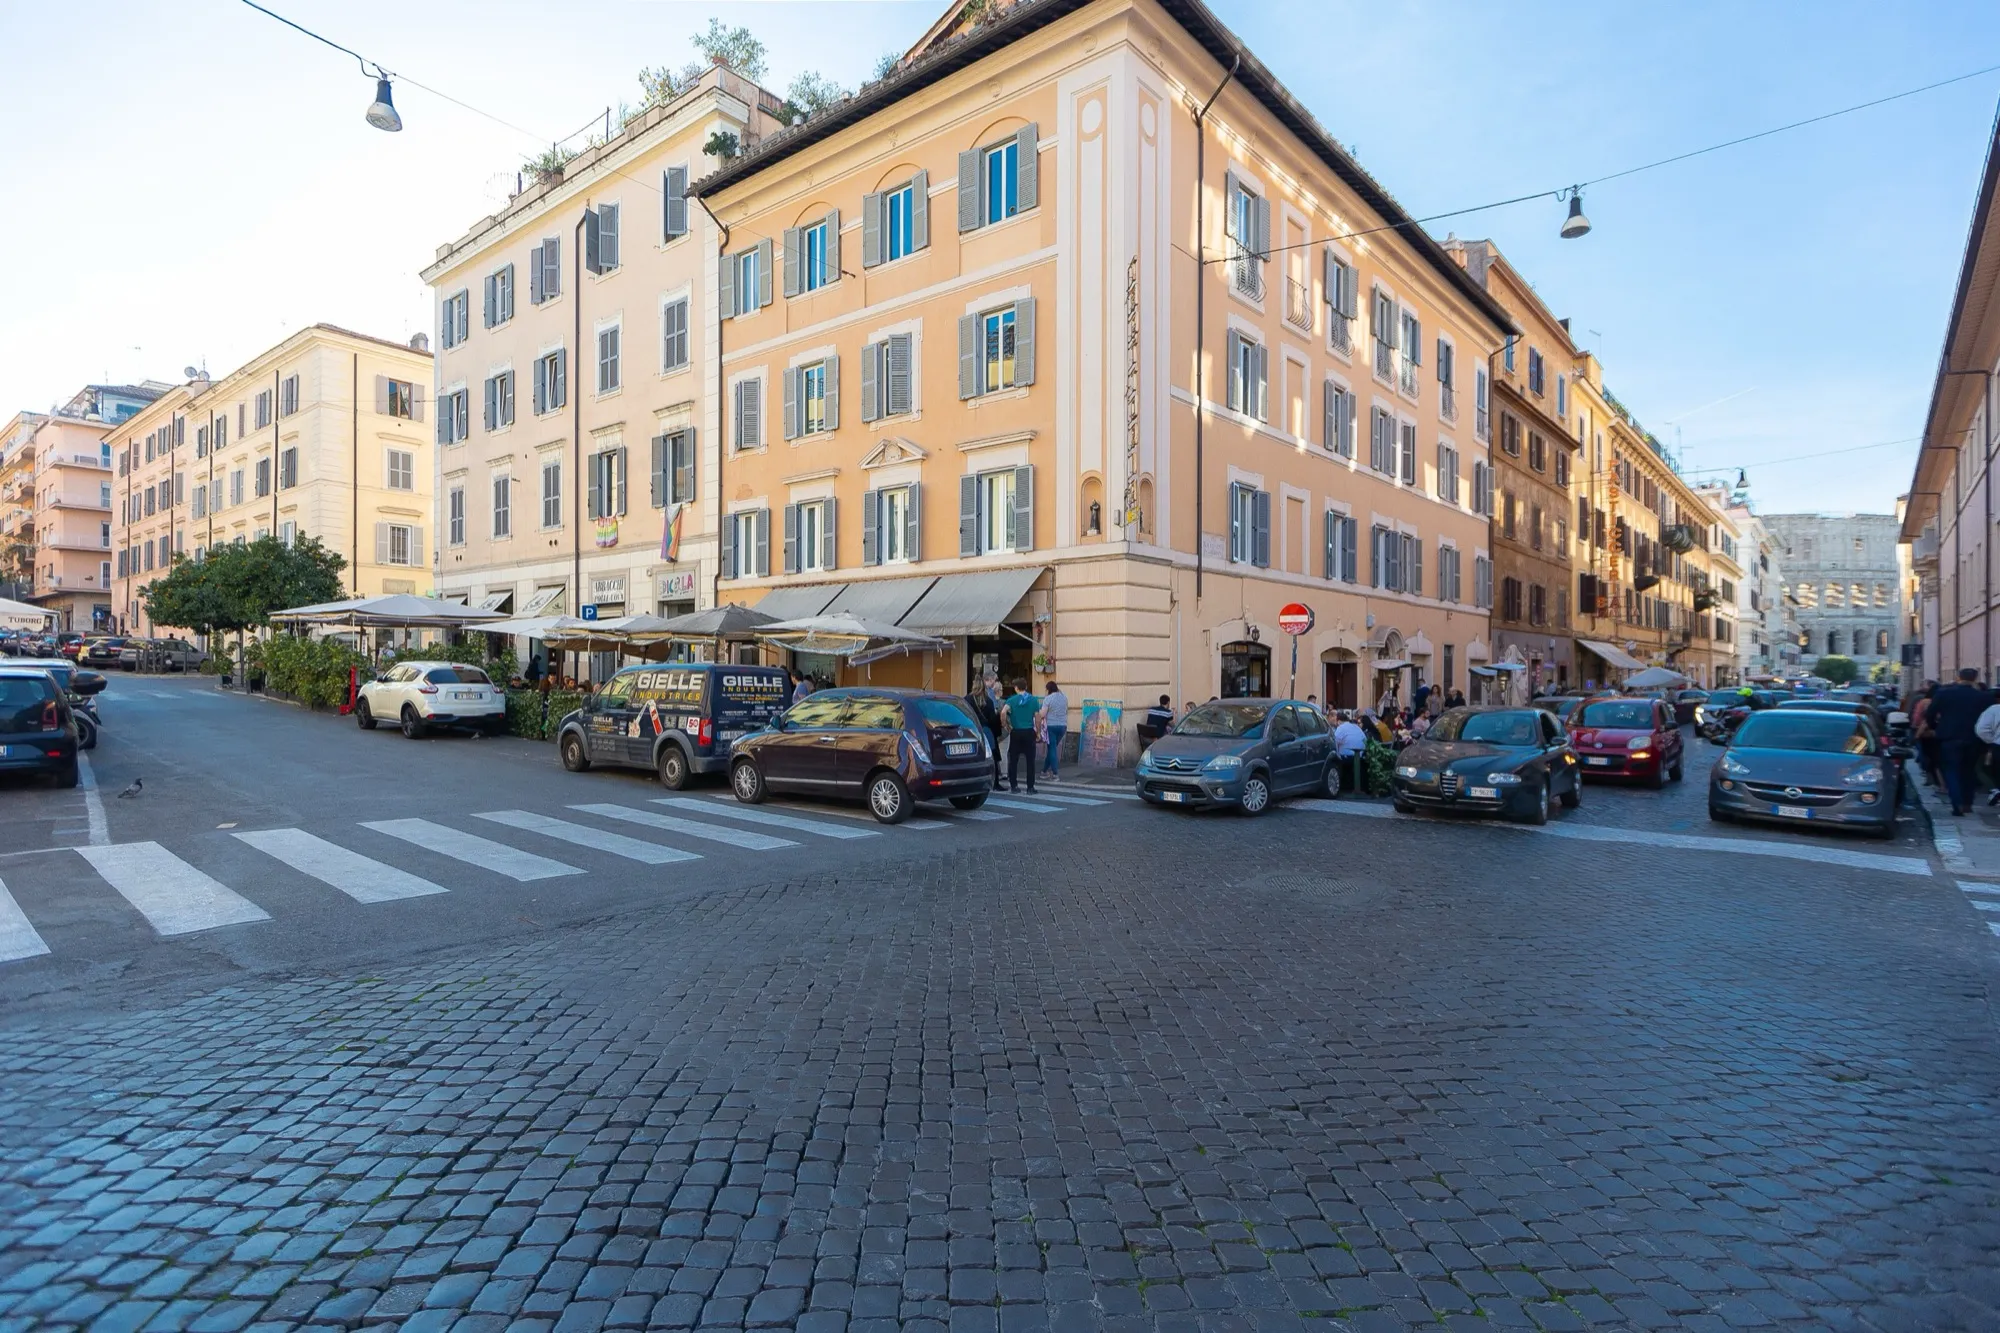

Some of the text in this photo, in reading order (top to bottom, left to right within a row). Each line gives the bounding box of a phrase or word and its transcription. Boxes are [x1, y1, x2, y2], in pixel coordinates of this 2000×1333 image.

[1608, 460, 1622, 608] PASTICCERIA
[586, 608, 593, 618] P
[8, 616, 42, 624] TUBORG
[637, 673, 703, 690] GIELLE
[723, 676, 783, 687] GIELLE
[634, 691, 701, 700] INDUSTRIES
